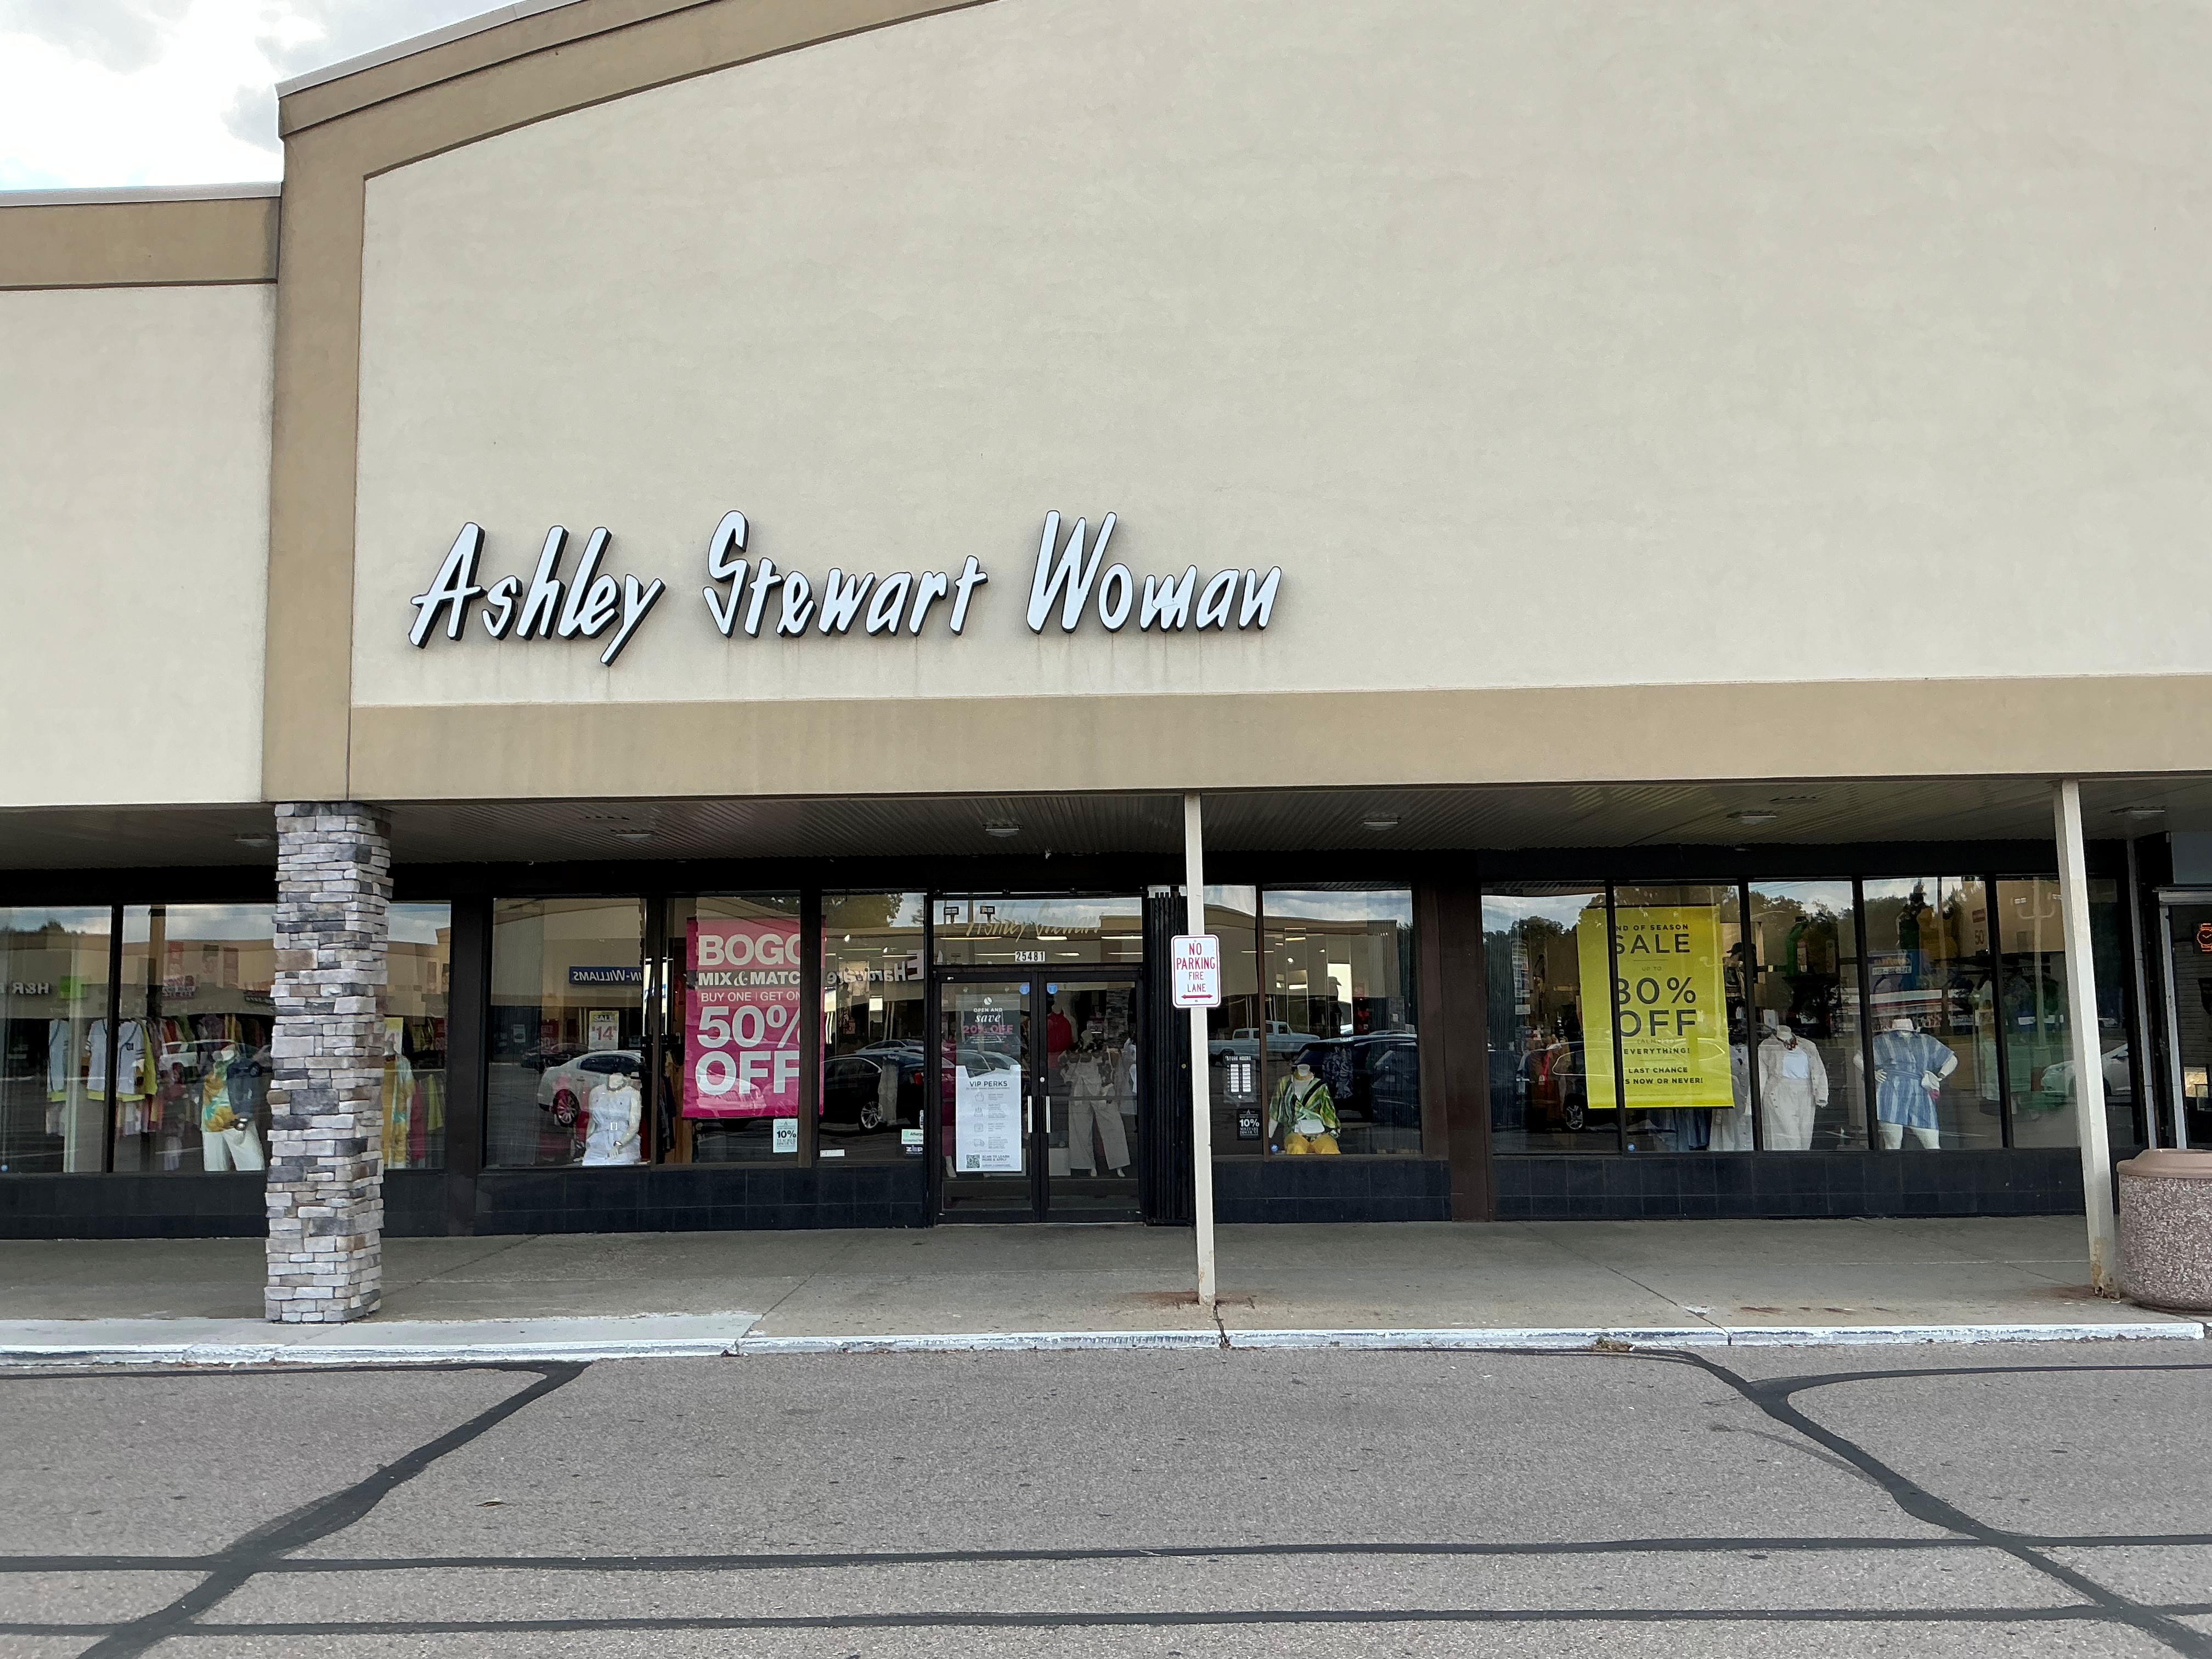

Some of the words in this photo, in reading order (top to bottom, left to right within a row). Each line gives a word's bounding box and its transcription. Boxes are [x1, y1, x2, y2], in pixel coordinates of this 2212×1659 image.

[409, 522, 665, 667] Ashley
[703, 510, 988, 637] Stewart
[1026, 510, 1282, 634] Woman
[1189, 943, 1202, 955] NO
[1616, 933, 1690, 954] SALE
[1016, 951, 1045, 962] 25481
[1176, 957, 1215, 970] PARKING
[698, 972, 732, 985] MIX
[734, 971, 748, 986] &
[750, 971, 800, 985] MATC
[1188, 972, 1204, 980] FIRE
[1187, 983, 1206, 992] LANE
[701, 992, 724, 1002] BUY
[727, 992, 752, 1001] ONE
[760, 991, 783, 1001] GET
[786, 991, 800, 1001] ON
[974, 1014, 1001, 1023] save
[1620, 1009, 1696, 1037] OFF
[697, 1005, 800, 1048] 50%
[695, 1050, 800, 1096] OFF
[1239, 1119, 1260, 1127] 10%
[776, 1130, 797, 1138] 10%
